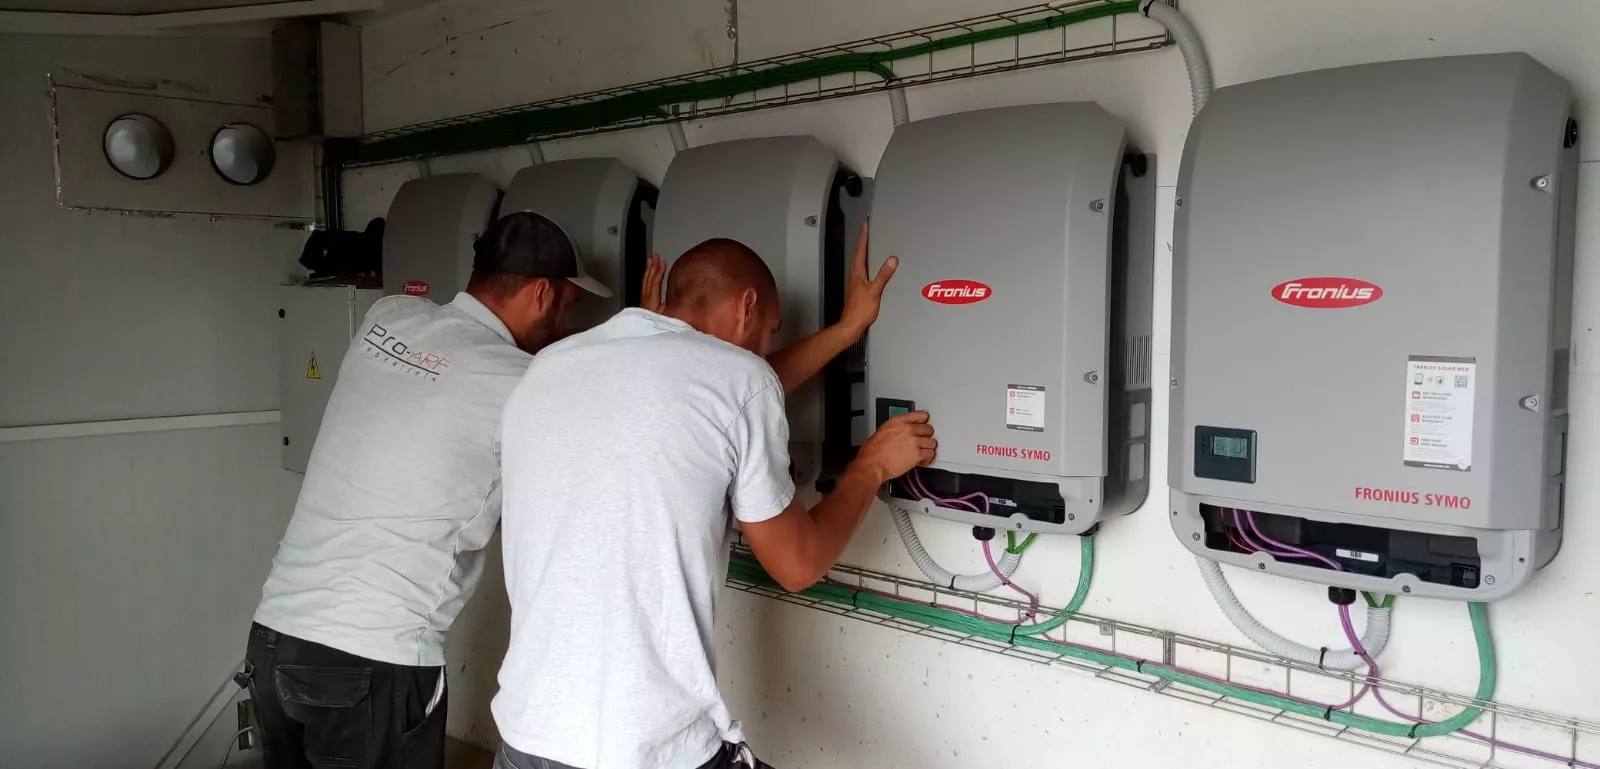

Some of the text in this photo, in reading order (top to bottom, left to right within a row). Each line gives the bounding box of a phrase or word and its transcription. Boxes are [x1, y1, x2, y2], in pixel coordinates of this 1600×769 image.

[927, 284, 986, 298] Fronius
[1281, 283, 1375, 299] Fronius
[976, 444, 1051, 461] FRONIUS SYMO
[1355, 487, 1471, 509] FRONIUS SYMO
